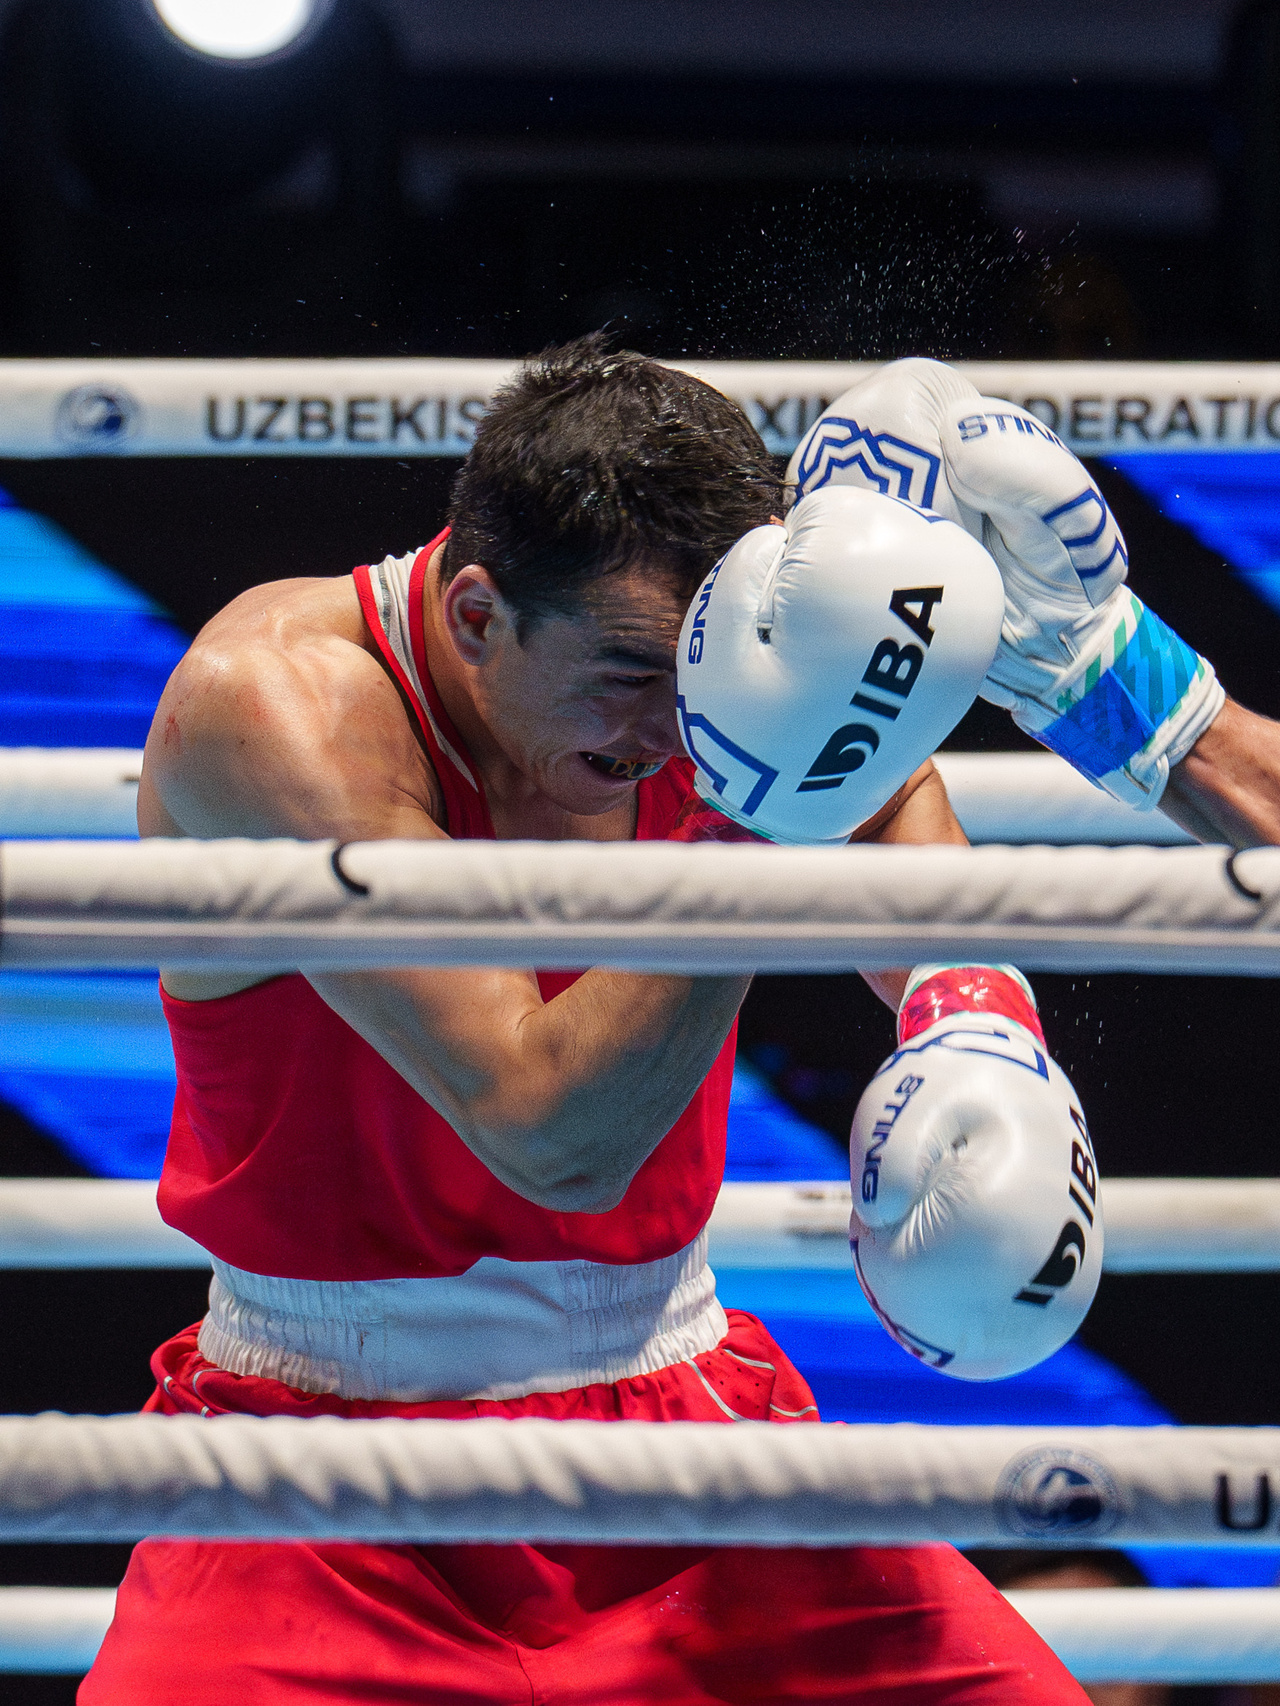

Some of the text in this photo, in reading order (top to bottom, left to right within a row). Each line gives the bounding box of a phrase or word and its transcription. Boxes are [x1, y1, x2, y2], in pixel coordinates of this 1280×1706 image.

[207, 395, 486, 441] UZBEKIS
[957, 413, 1068, 450] STIN
[861, 1074, 925, 1203] STING
